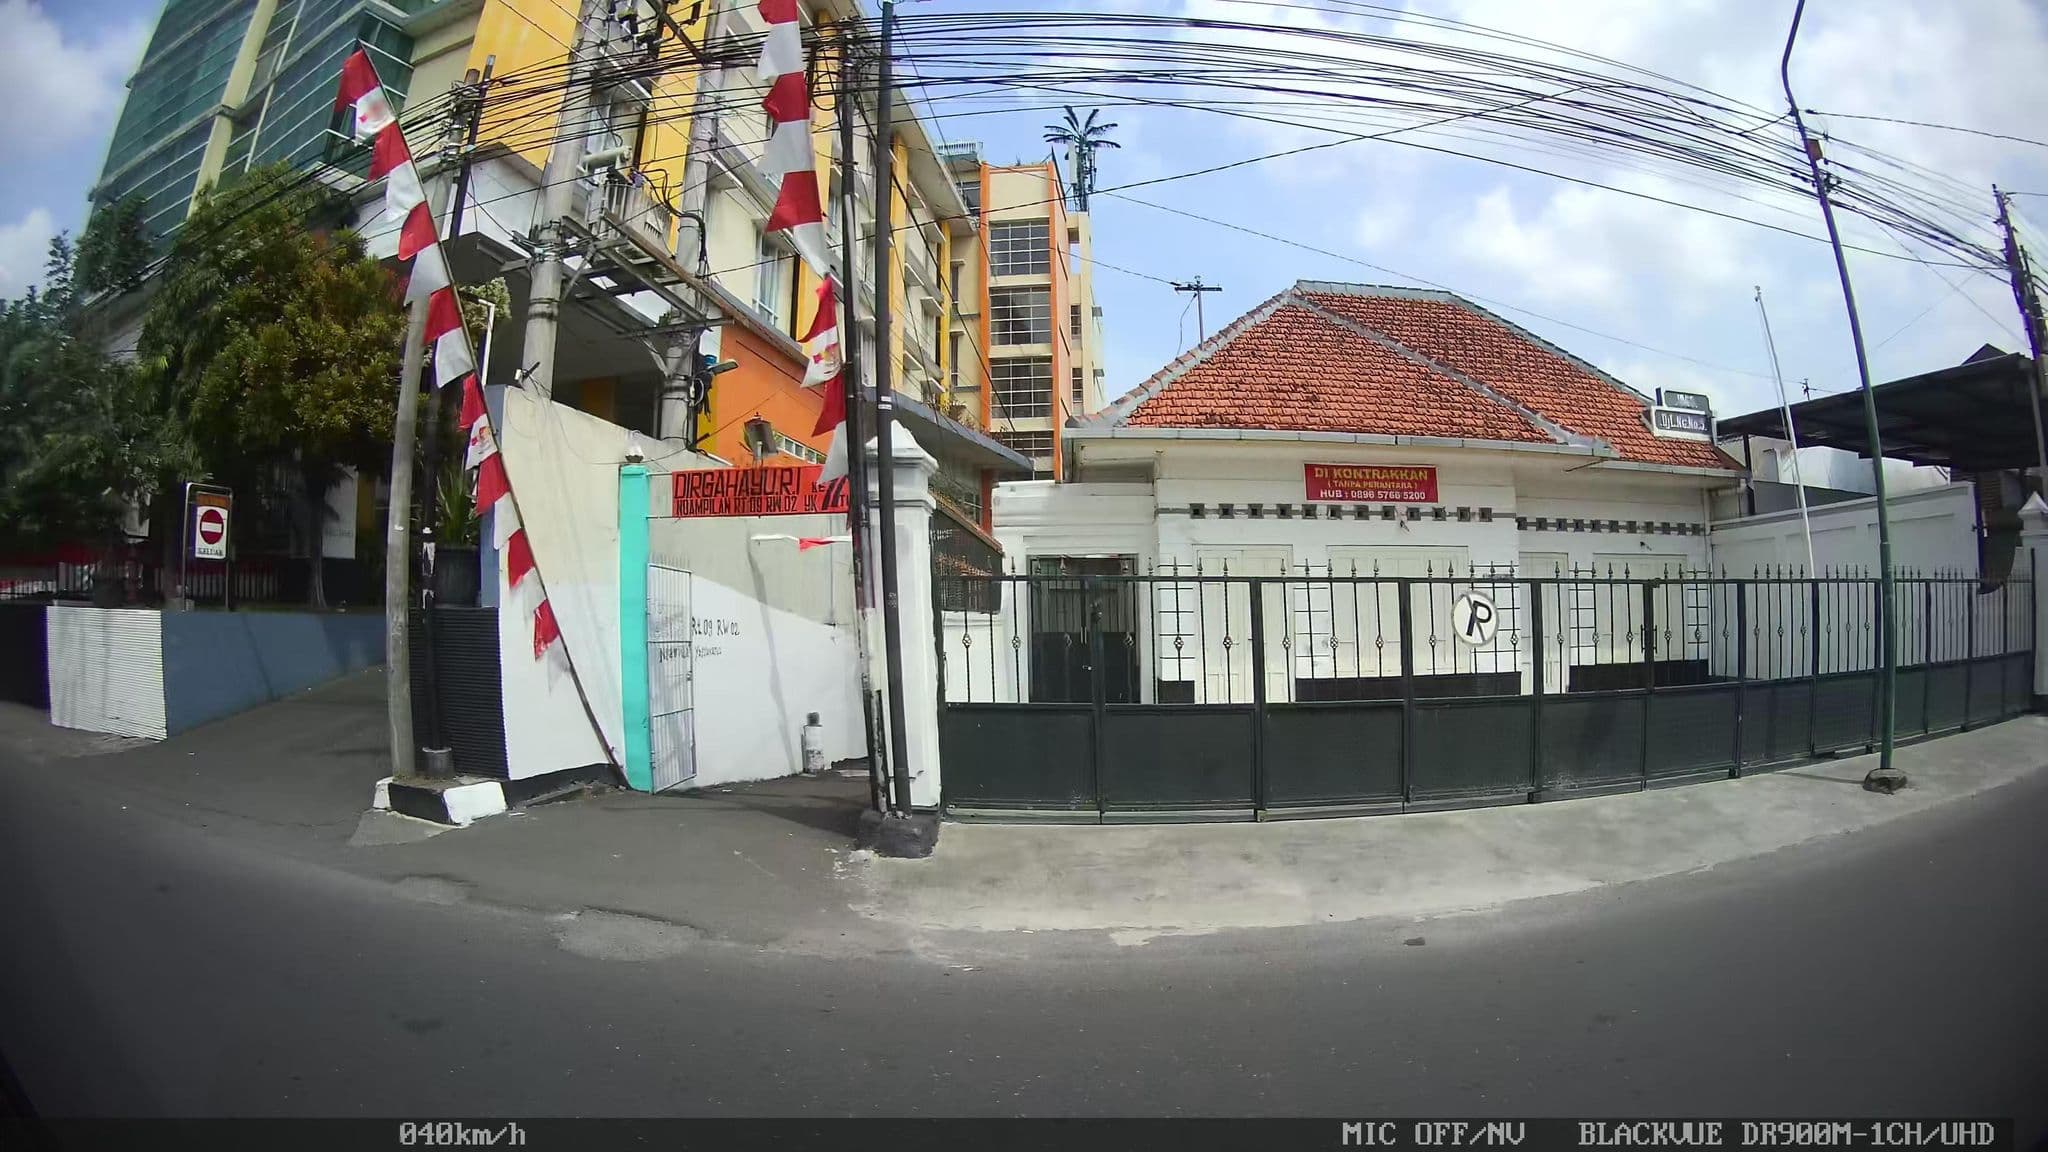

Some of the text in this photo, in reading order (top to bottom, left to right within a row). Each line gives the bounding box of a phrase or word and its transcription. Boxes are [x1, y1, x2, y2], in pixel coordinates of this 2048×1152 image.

[1314, 467, 1428, 481] DI KONTRAKKAN
[1320, 489, 1342, 498] HUB
[1403, 491, 1426, 500] 5200
